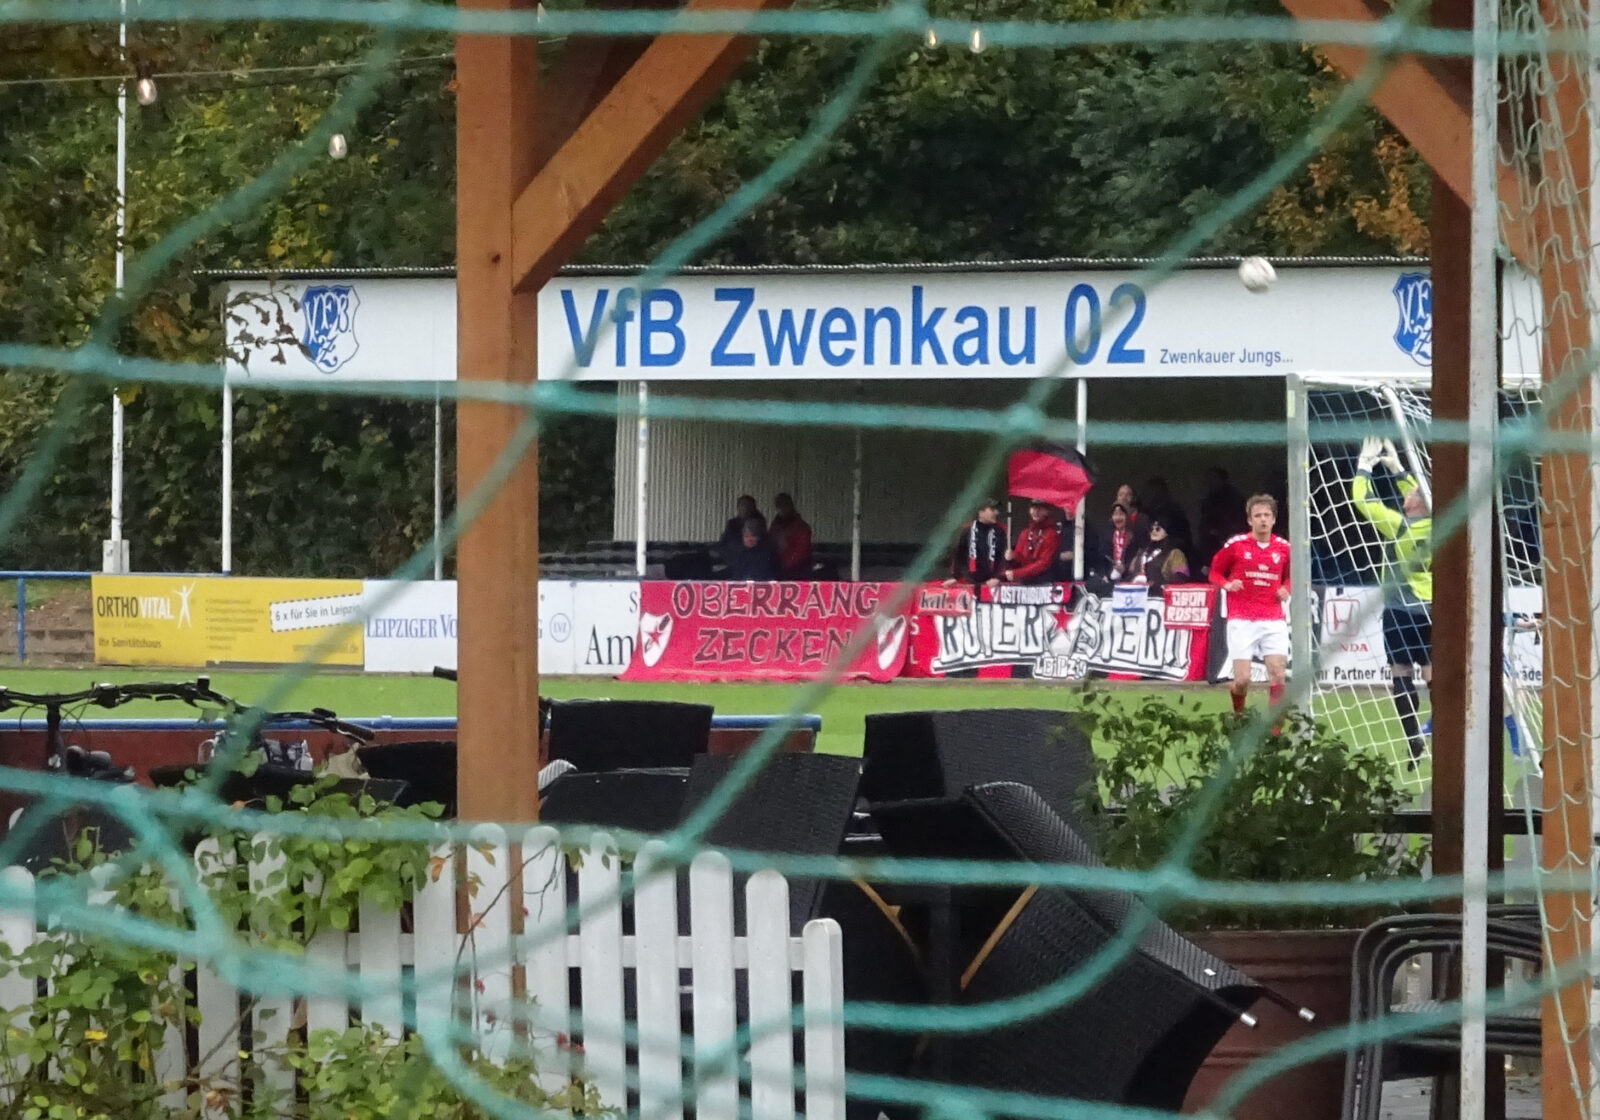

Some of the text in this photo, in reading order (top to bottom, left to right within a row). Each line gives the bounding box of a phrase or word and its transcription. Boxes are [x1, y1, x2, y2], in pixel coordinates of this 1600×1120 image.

[560, 282, 1147, 368] VfB Zwenkau 02
[1159, 348, 1235, 365] Zwenkauer
[672, 581, 881, 620] OBERRANG
[275, 610, 281, 622] 6
[291, 608, 303, 620] für
[305, 607, 318, 619] Sie
[320, 605, 328, 616] in
[366, 614, 438, 639] LEIPZIGER
[692, 627, 854, 665] ZECKEN
[1334, 666, 1376, 681] Partner
[1380, 665, 1393, 681] fü
